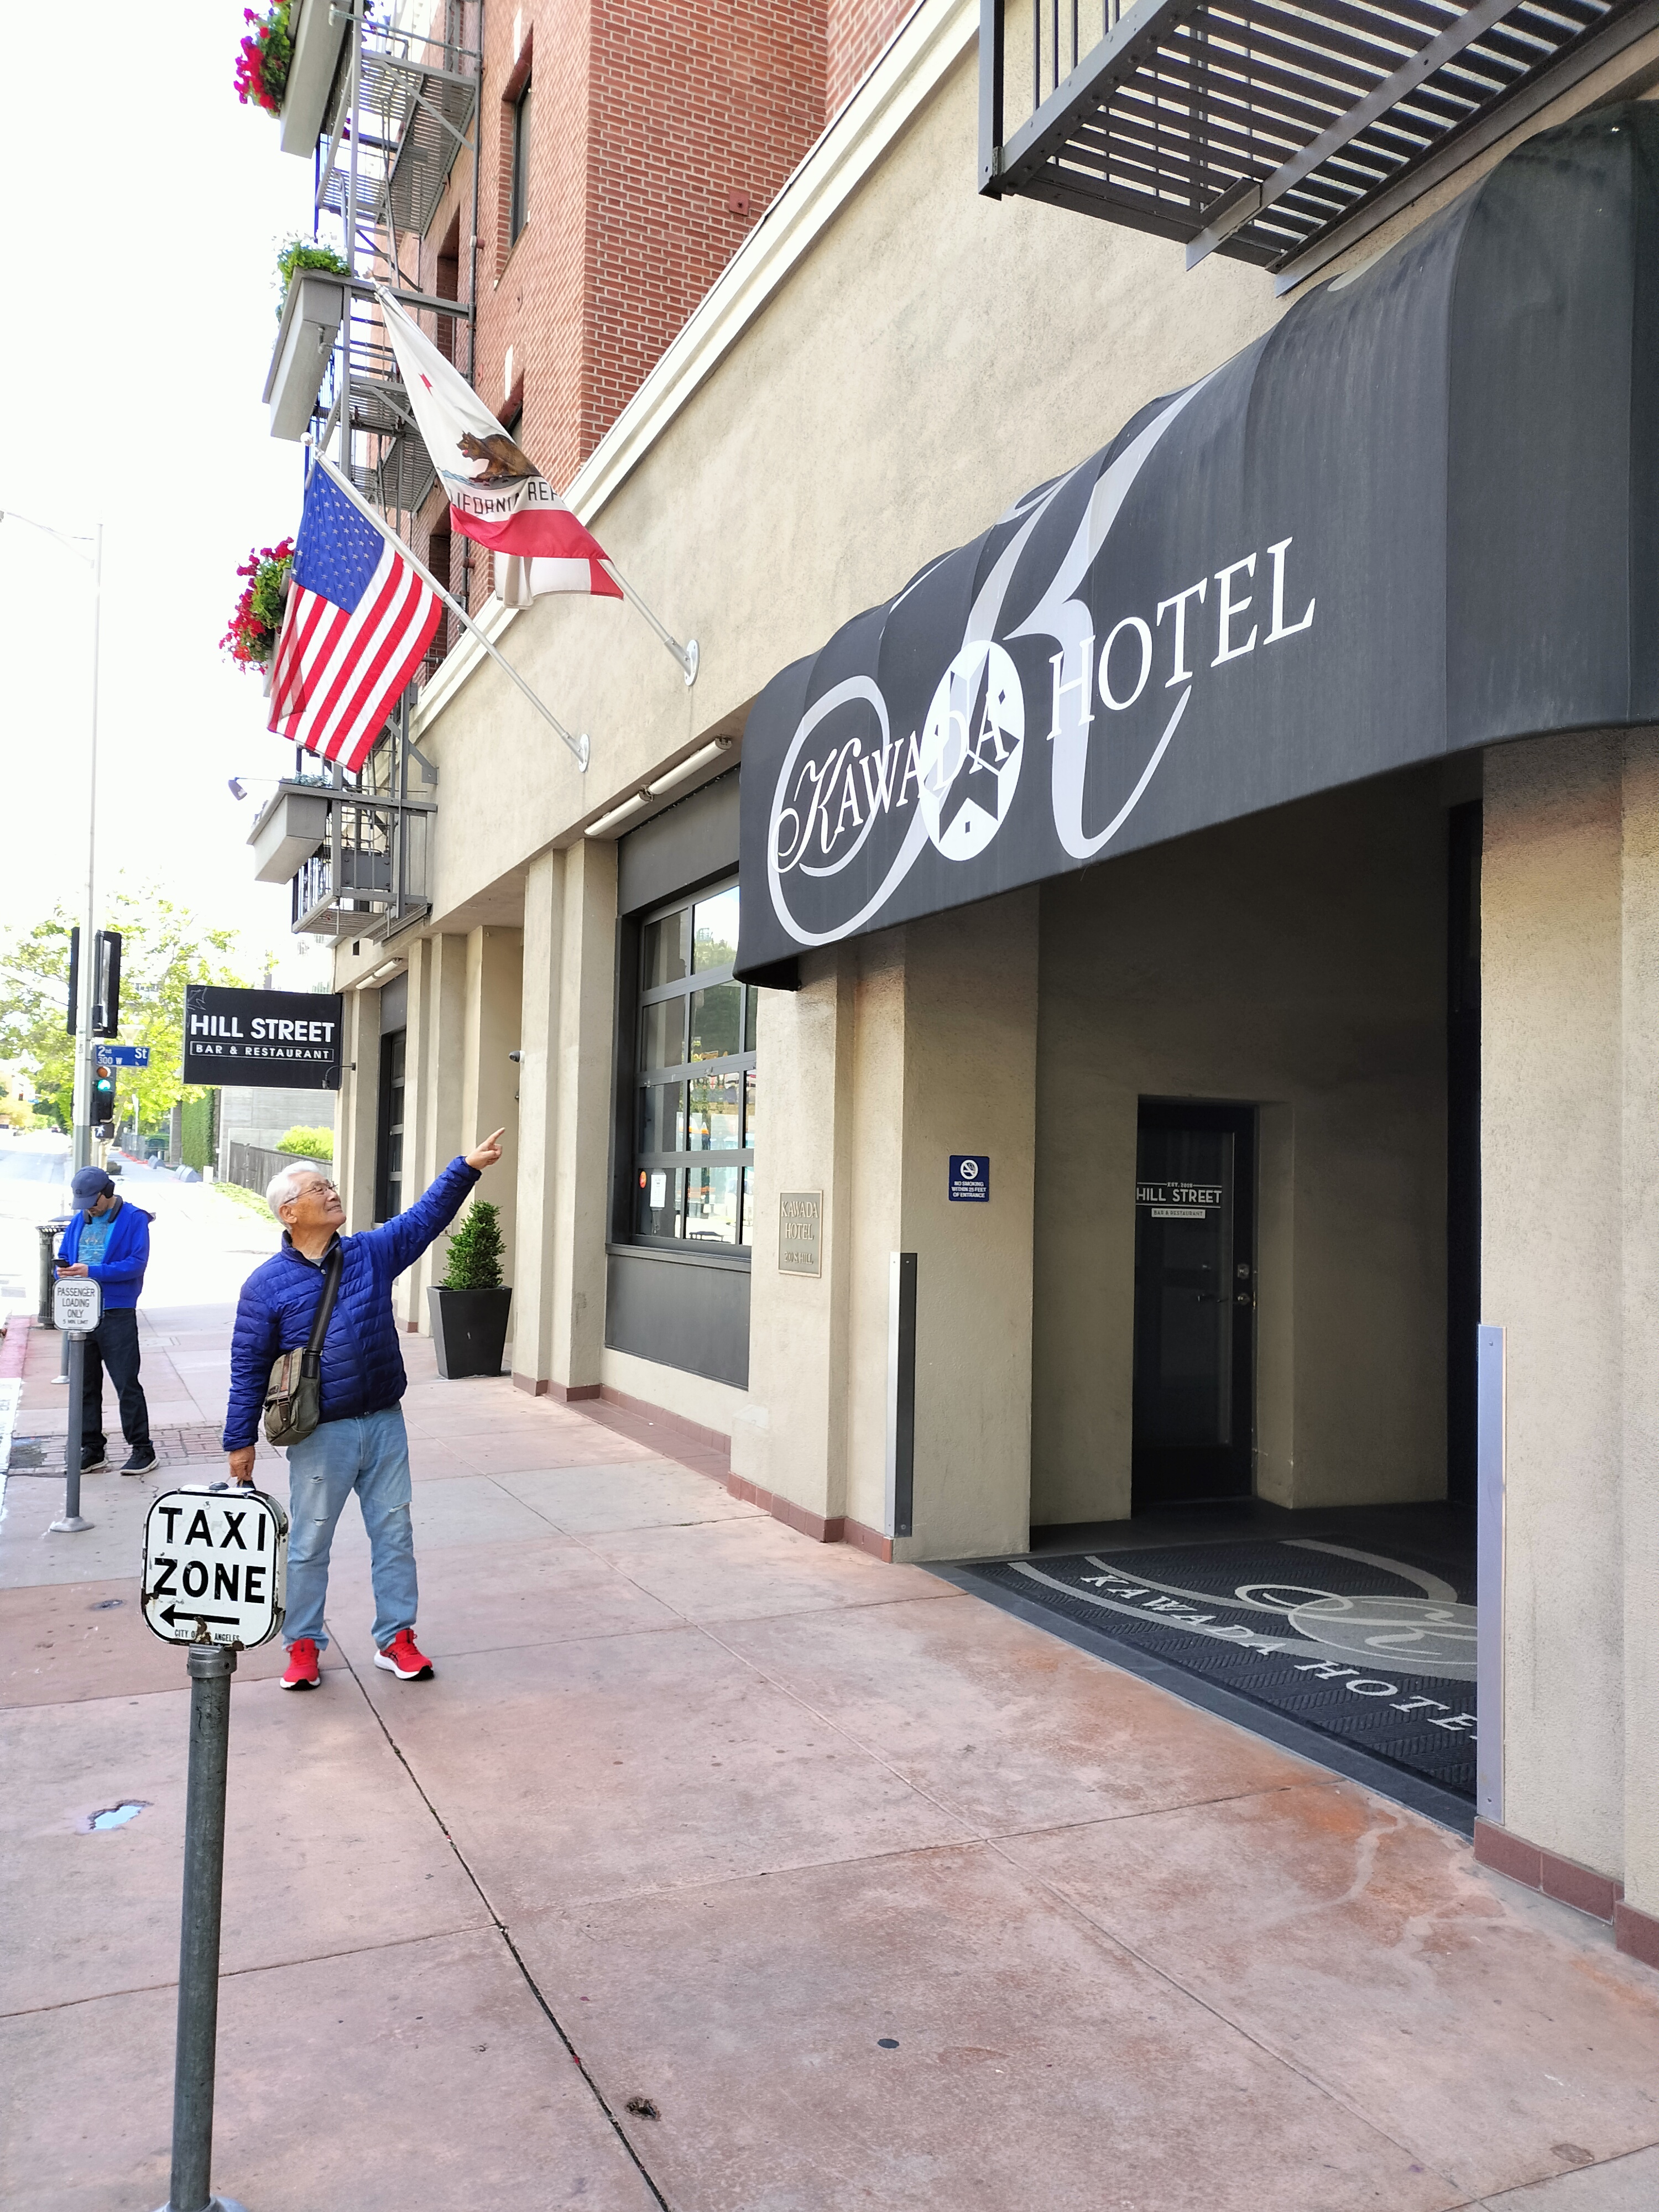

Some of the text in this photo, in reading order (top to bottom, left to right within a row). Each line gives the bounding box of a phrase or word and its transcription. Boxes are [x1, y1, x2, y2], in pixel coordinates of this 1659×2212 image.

[772, 536, 1316, 873] KAWADA HOTEL
[190, 1014, 335, 1042] HILL STREET
[134, 1047, 148, 1059] St
[196, 1044, 330, 1060] BAR & RESTAURANT
[97, 1056, 113, 1065] 300
[1136, 1187, 1222, 1203] HILL STREET
[781, 1201, 819, 1218] KAWADA
[785, 1223, 814, 1240] HOTEL
[799, 1253, 814, 1265] HILL
[57, 1287, 95, 1297] PASSENGER
[62, 1298, 90, 1308] LOADING
[67, 1309, 84, 1318] ONLY
[158, 1506, 266, 1551] TAXI
[153, 1557, 266, 1604] ZONE
[1081, 1574, 1286, 1655] KAWADA
[175, 1629, 189, 1638] CITY
[214, 1633, 240, 1642] ANGELES
[1294, 1661, 1478, 1740] HOTE
